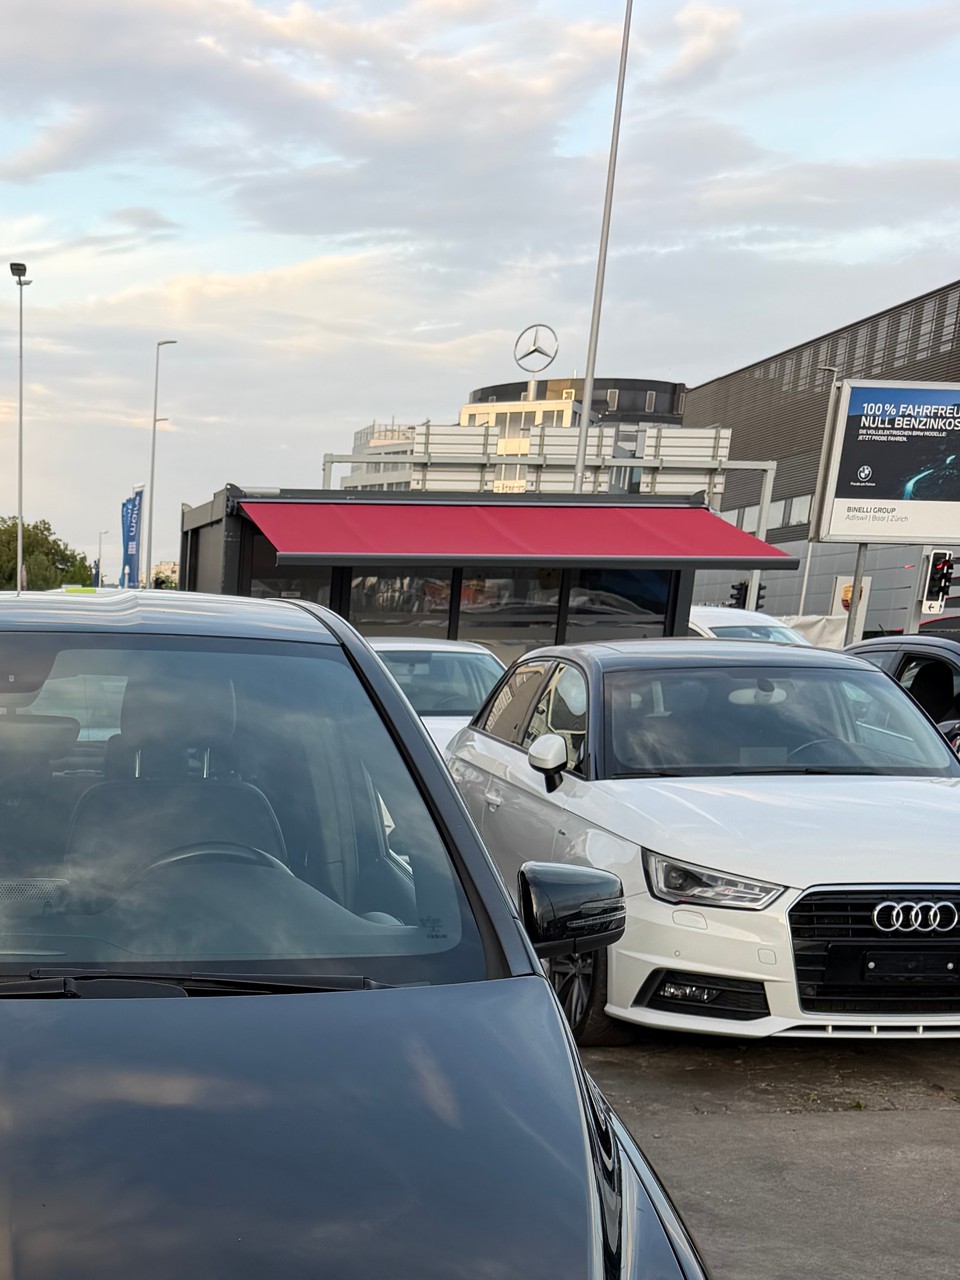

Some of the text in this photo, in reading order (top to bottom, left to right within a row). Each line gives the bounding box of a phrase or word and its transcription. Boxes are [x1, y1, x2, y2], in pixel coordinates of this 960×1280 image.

[862, 403, 883, 415] 100
[884, 404, 897, 415] %
[860, 416, 892, 428] NULL
[846, 506, 872, 514] BINELLI
